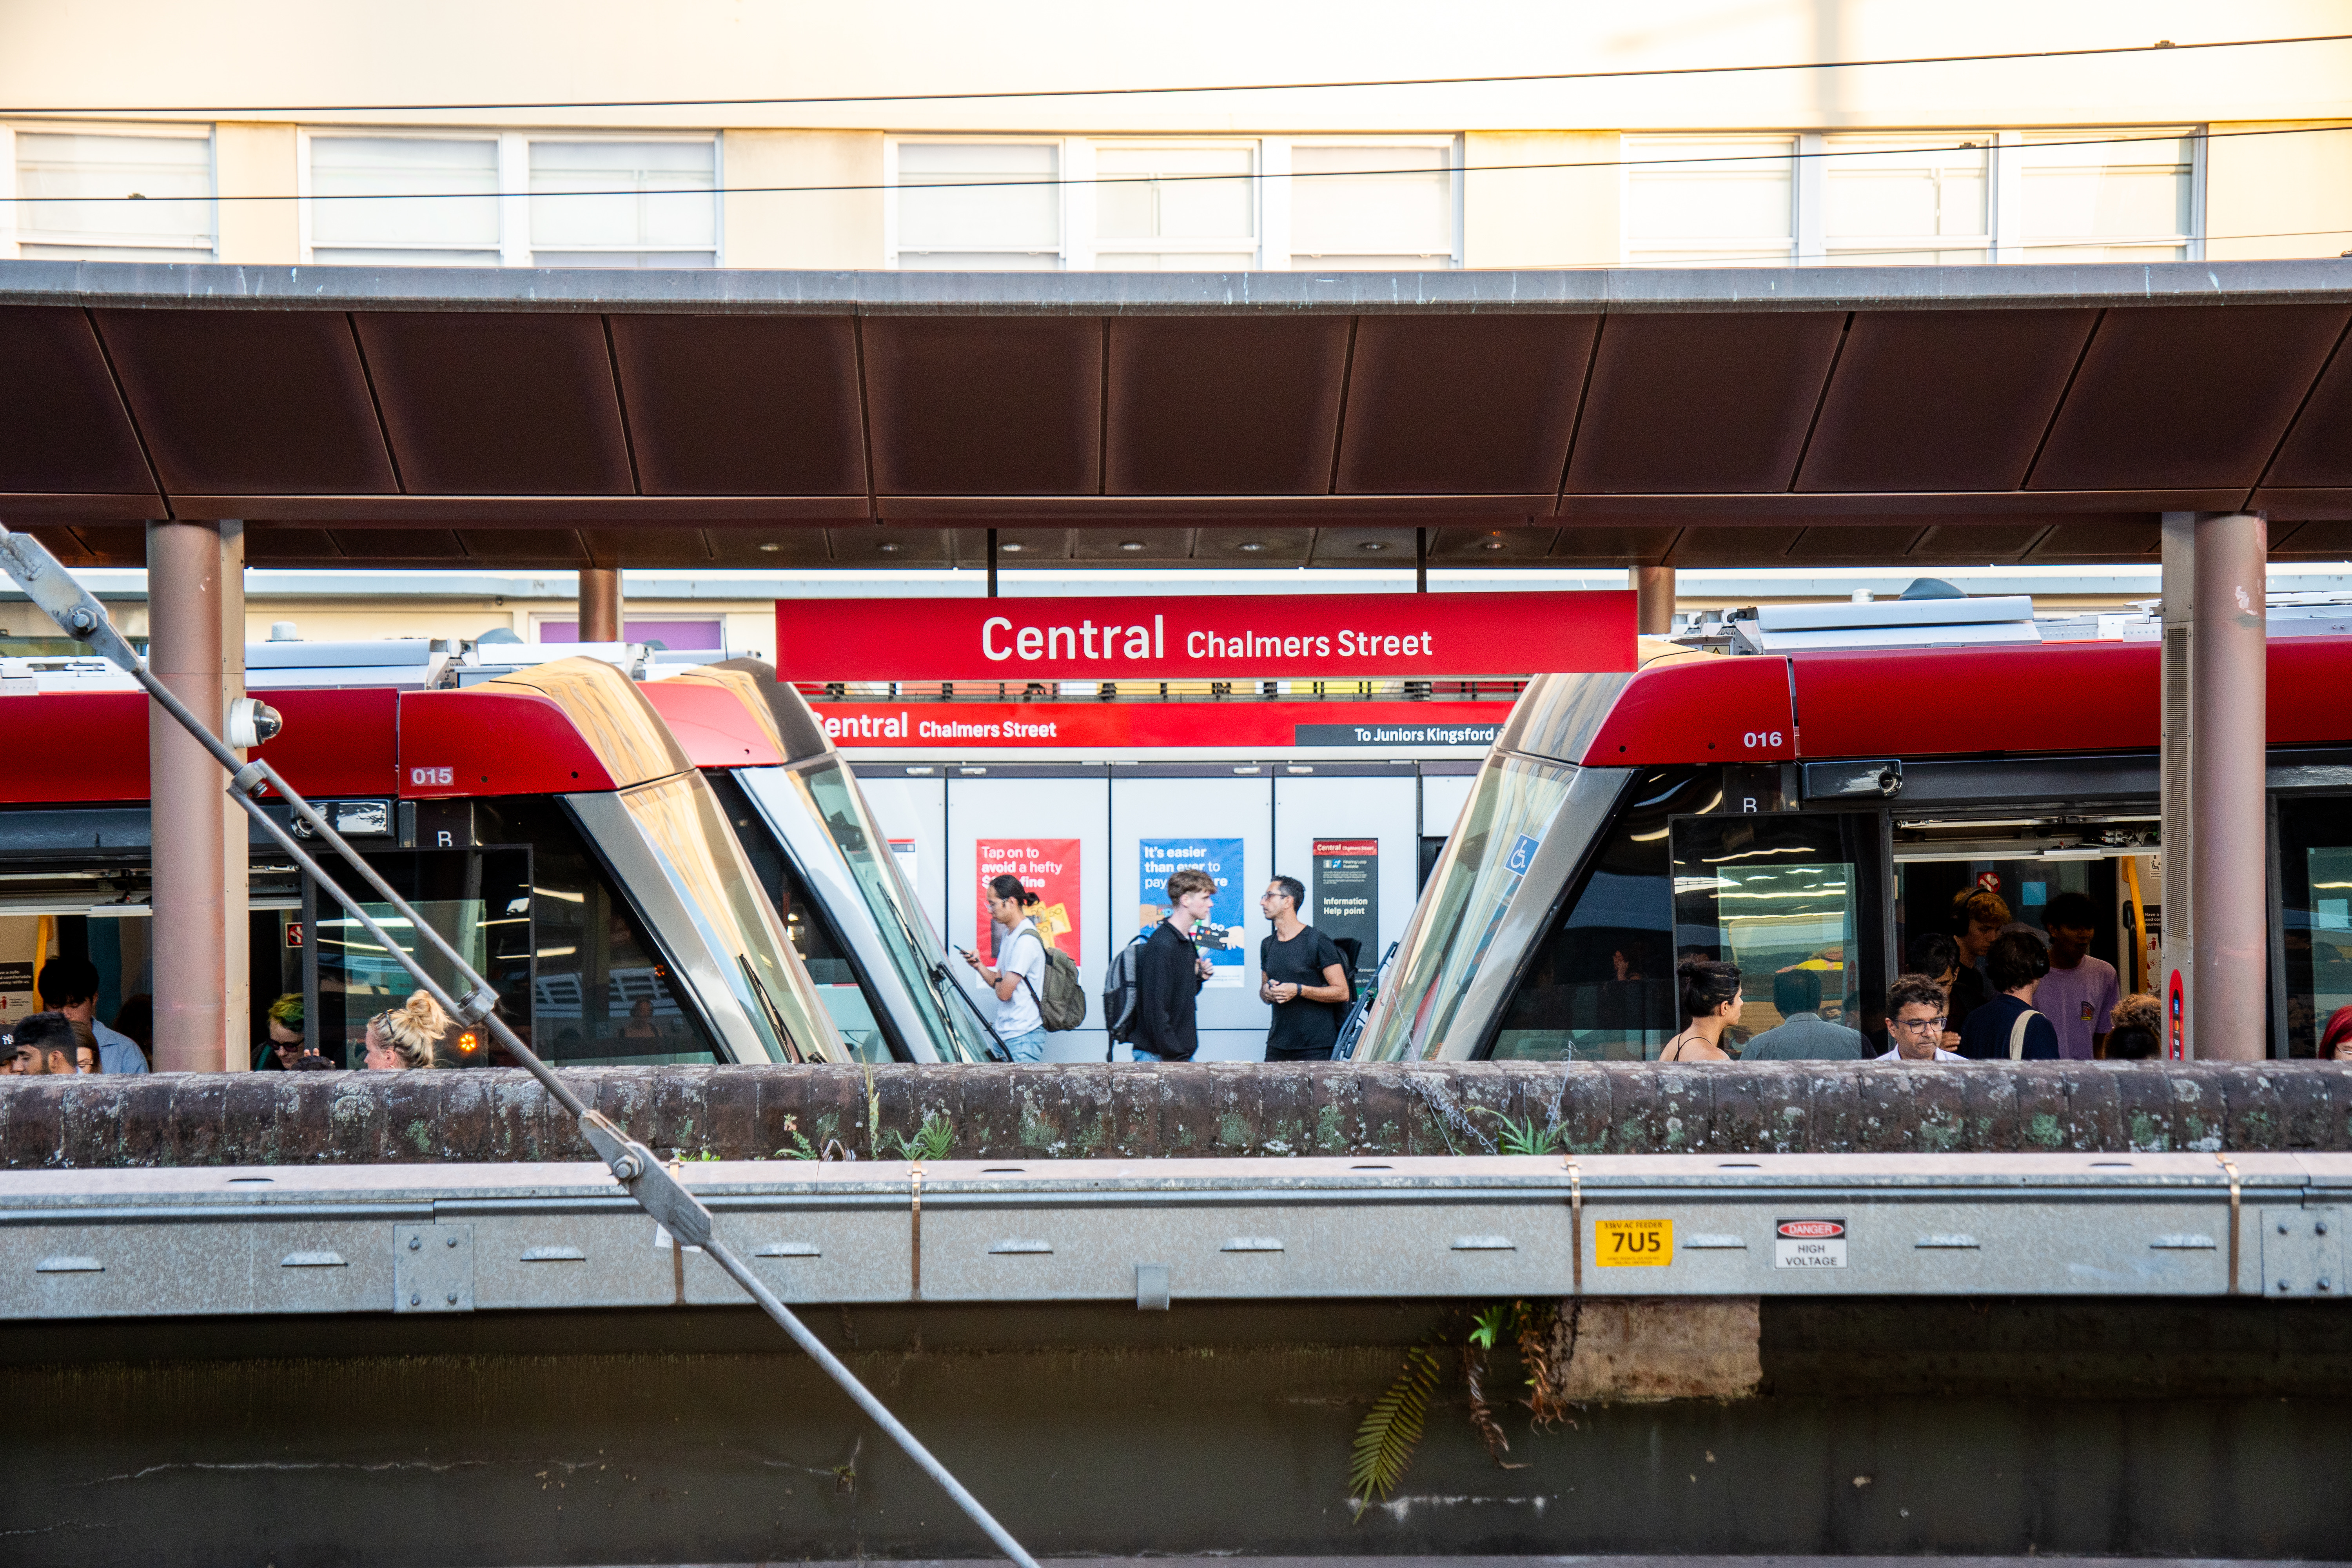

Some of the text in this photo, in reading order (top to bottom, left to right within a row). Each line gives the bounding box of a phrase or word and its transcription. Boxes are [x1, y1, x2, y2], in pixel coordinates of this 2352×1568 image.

[982, 614, 1433, 661] Central Chalmers Street
[919, 720, 1000, 738] Chalmers
[1002, 721, 1057, 738] Street
[1354, 727, 1494, 744] To Juniors Kingsford
[1744, 731, 1782, 748] 016
[412, 768, 452, 784] 015
[981, 846, 1040, 860] Tap on to
[1166, 846, 1207, 858] easier
[981, 861, 1063, 875] avoid a hefty
[1144, 861, 1221, 873] than ever to
[1019, 875, 1045, 888] fine
[1145, 878, 1168, 889] pay
[1323, 897, 1368, 906] Information
[1323, 907, 1365, 916] Help point
[1789, 1225, 1832, 1234] DANGER
[1612, 1232, 1661, 1253] 7U5
[1798, 1244, 1825, 1253] HIGH
[1785, 1257, 1837, 1266] VOLTAGE
